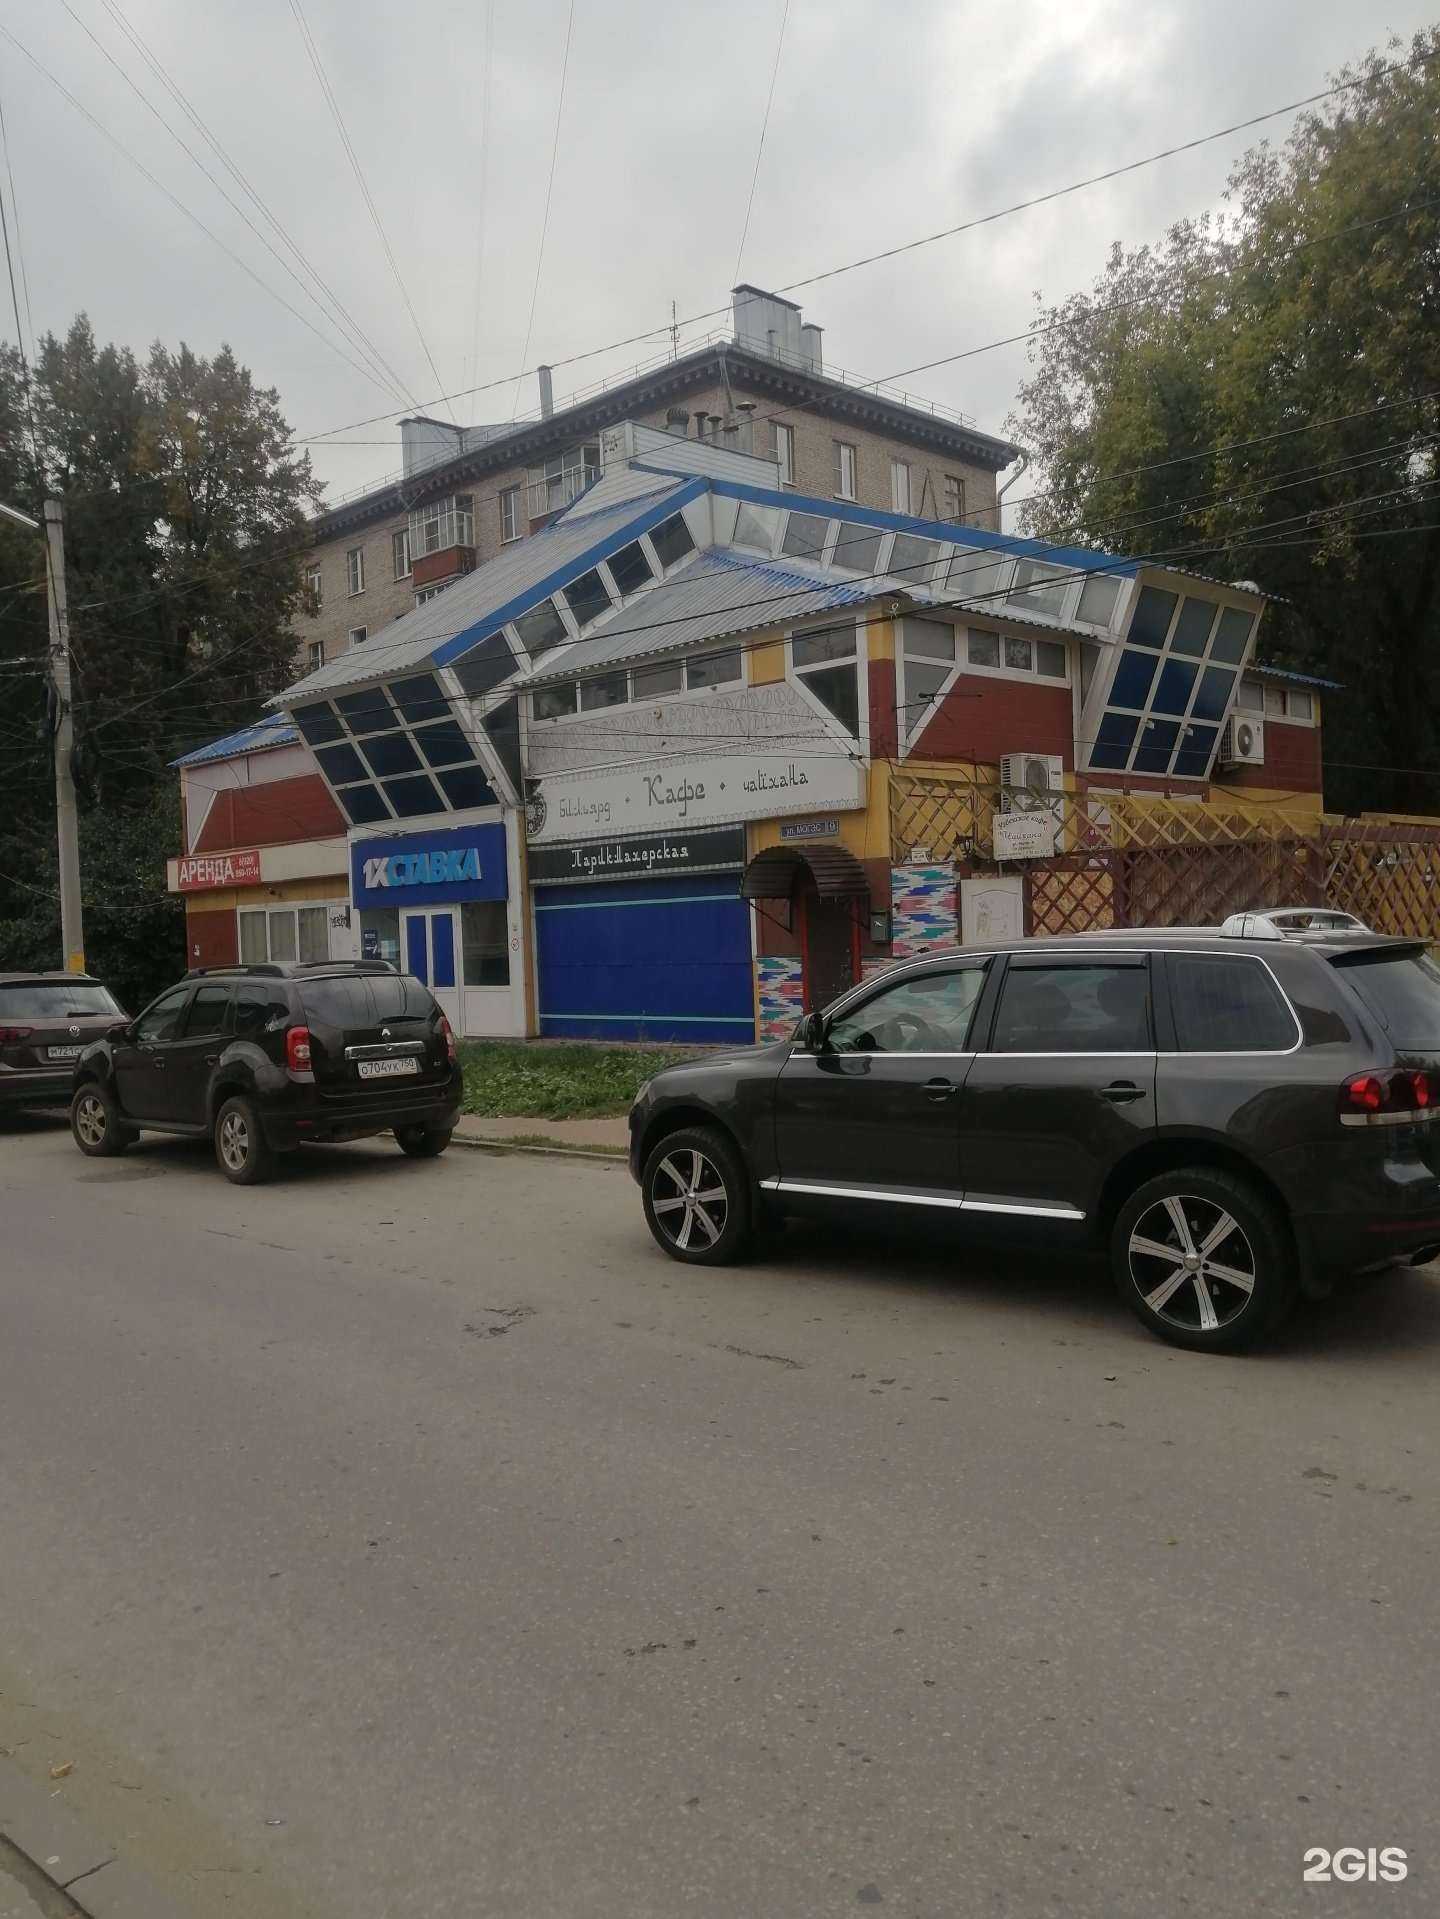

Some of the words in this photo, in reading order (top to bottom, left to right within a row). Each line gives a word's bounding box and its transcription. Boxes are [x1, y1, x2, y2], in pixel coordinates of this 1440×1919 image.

[643, 774, 706, 817] Кафе
[180, 858, 236, 885] АРЕНДА
[571, 840, 689, 874] Парикмахерская
